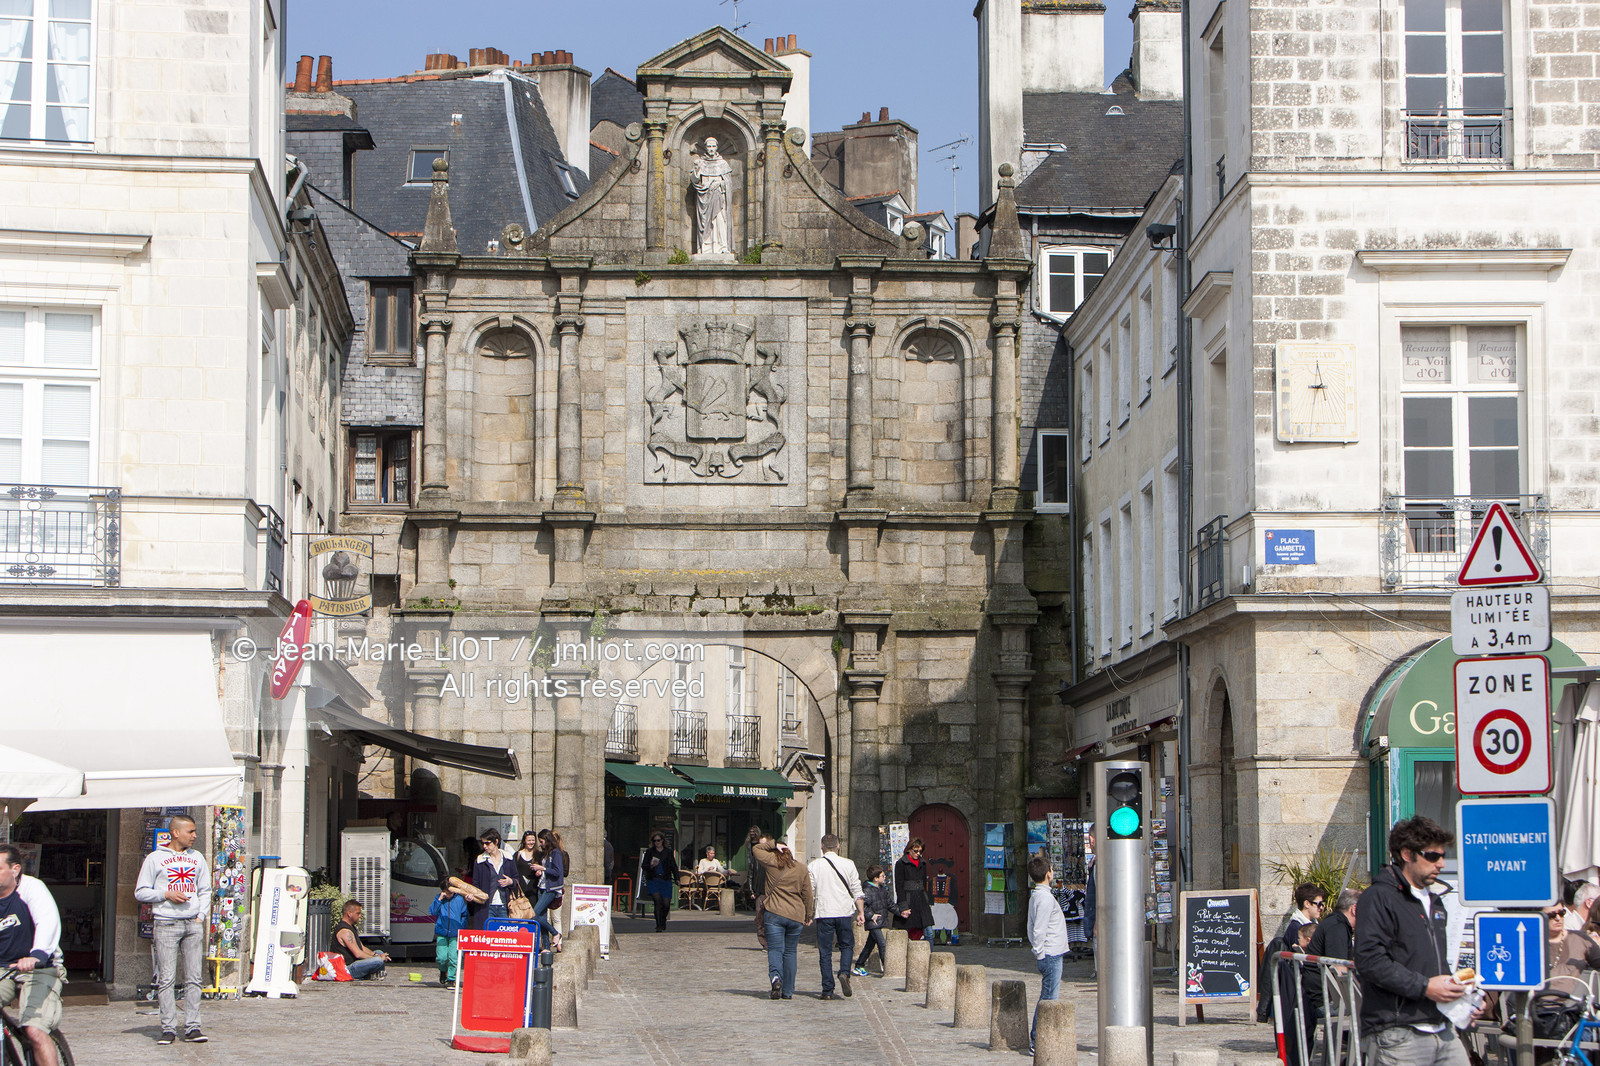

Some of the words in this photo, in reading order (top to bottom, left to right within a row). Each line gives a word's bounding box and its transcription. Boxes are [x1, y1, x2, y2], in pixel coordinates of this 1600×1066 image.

[1406, 356, 1420, 366] La
[1480, 356, 1494, 366] La
[313, 539, 368, 553] BOULANGER
[318, 599, 367, 613] PATISSIER
[1466, 593, 1533, 608] HAUTEUR
[1487, 628, 1532, 649] 3,4m
[1469, 673, 1533, 694] ZONE
[1486, 728, 1520, 755] 30
[643, 786, 652, 796] LE
[653, 787, 679, 797] SINAGOT
[722, 785, 735, 795] BAR
[738, 786, 769, 797] BRASSERIE
[1464, 832, 1547, 845] STATIONNEMENT
[1487, 860, 1527, 872] PAYANT
[470, 935, 517, 944] Télégramme
